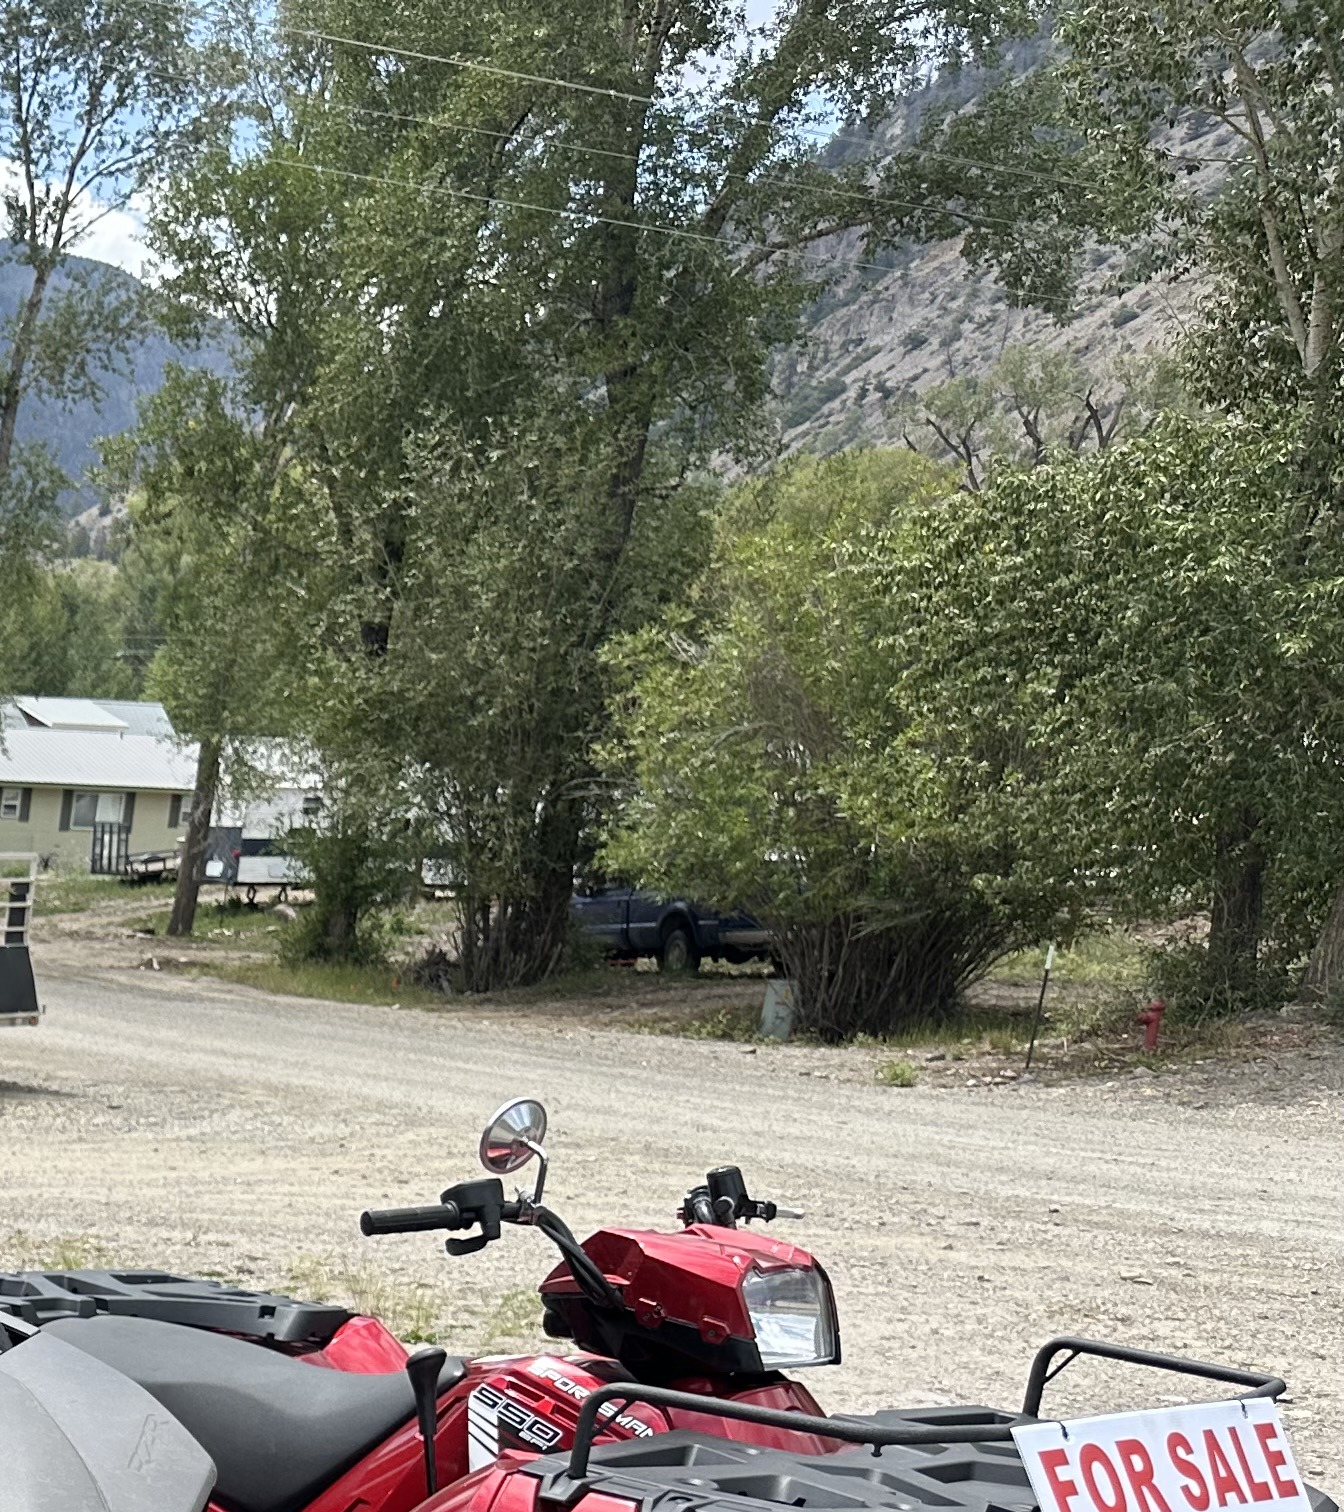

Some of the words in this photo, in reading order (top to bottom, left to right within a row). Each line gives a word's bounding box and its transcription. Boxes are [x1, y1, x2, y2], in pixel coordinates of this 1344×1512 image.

[475, 1383, 562, 1447] 550
[526, 1363, 654, 1438] SPORSMAN
[1166, 1421, 1300, 1512] SALE
